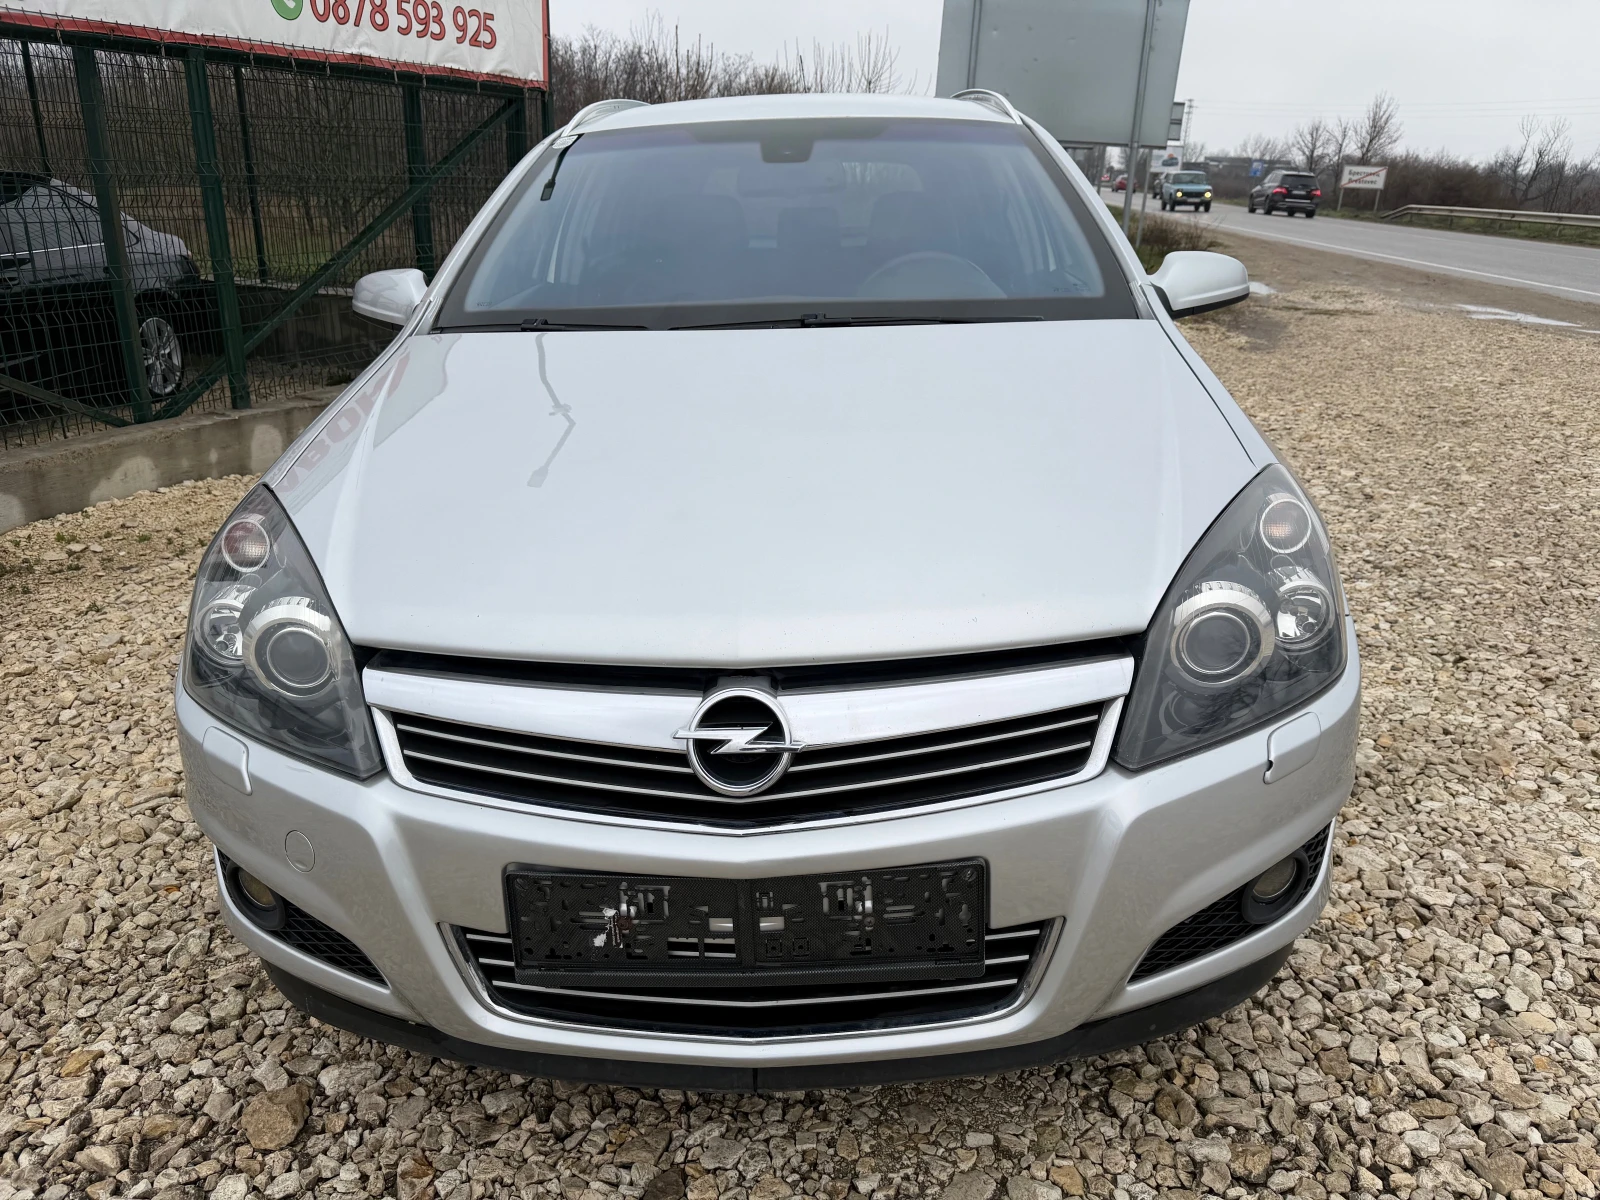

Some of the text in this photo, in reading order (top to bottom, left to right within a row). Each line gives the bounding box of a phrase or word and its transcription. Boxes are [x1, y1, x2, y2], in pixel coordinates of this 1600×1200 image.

[310, 0, 497, 49] 0878 593 925
